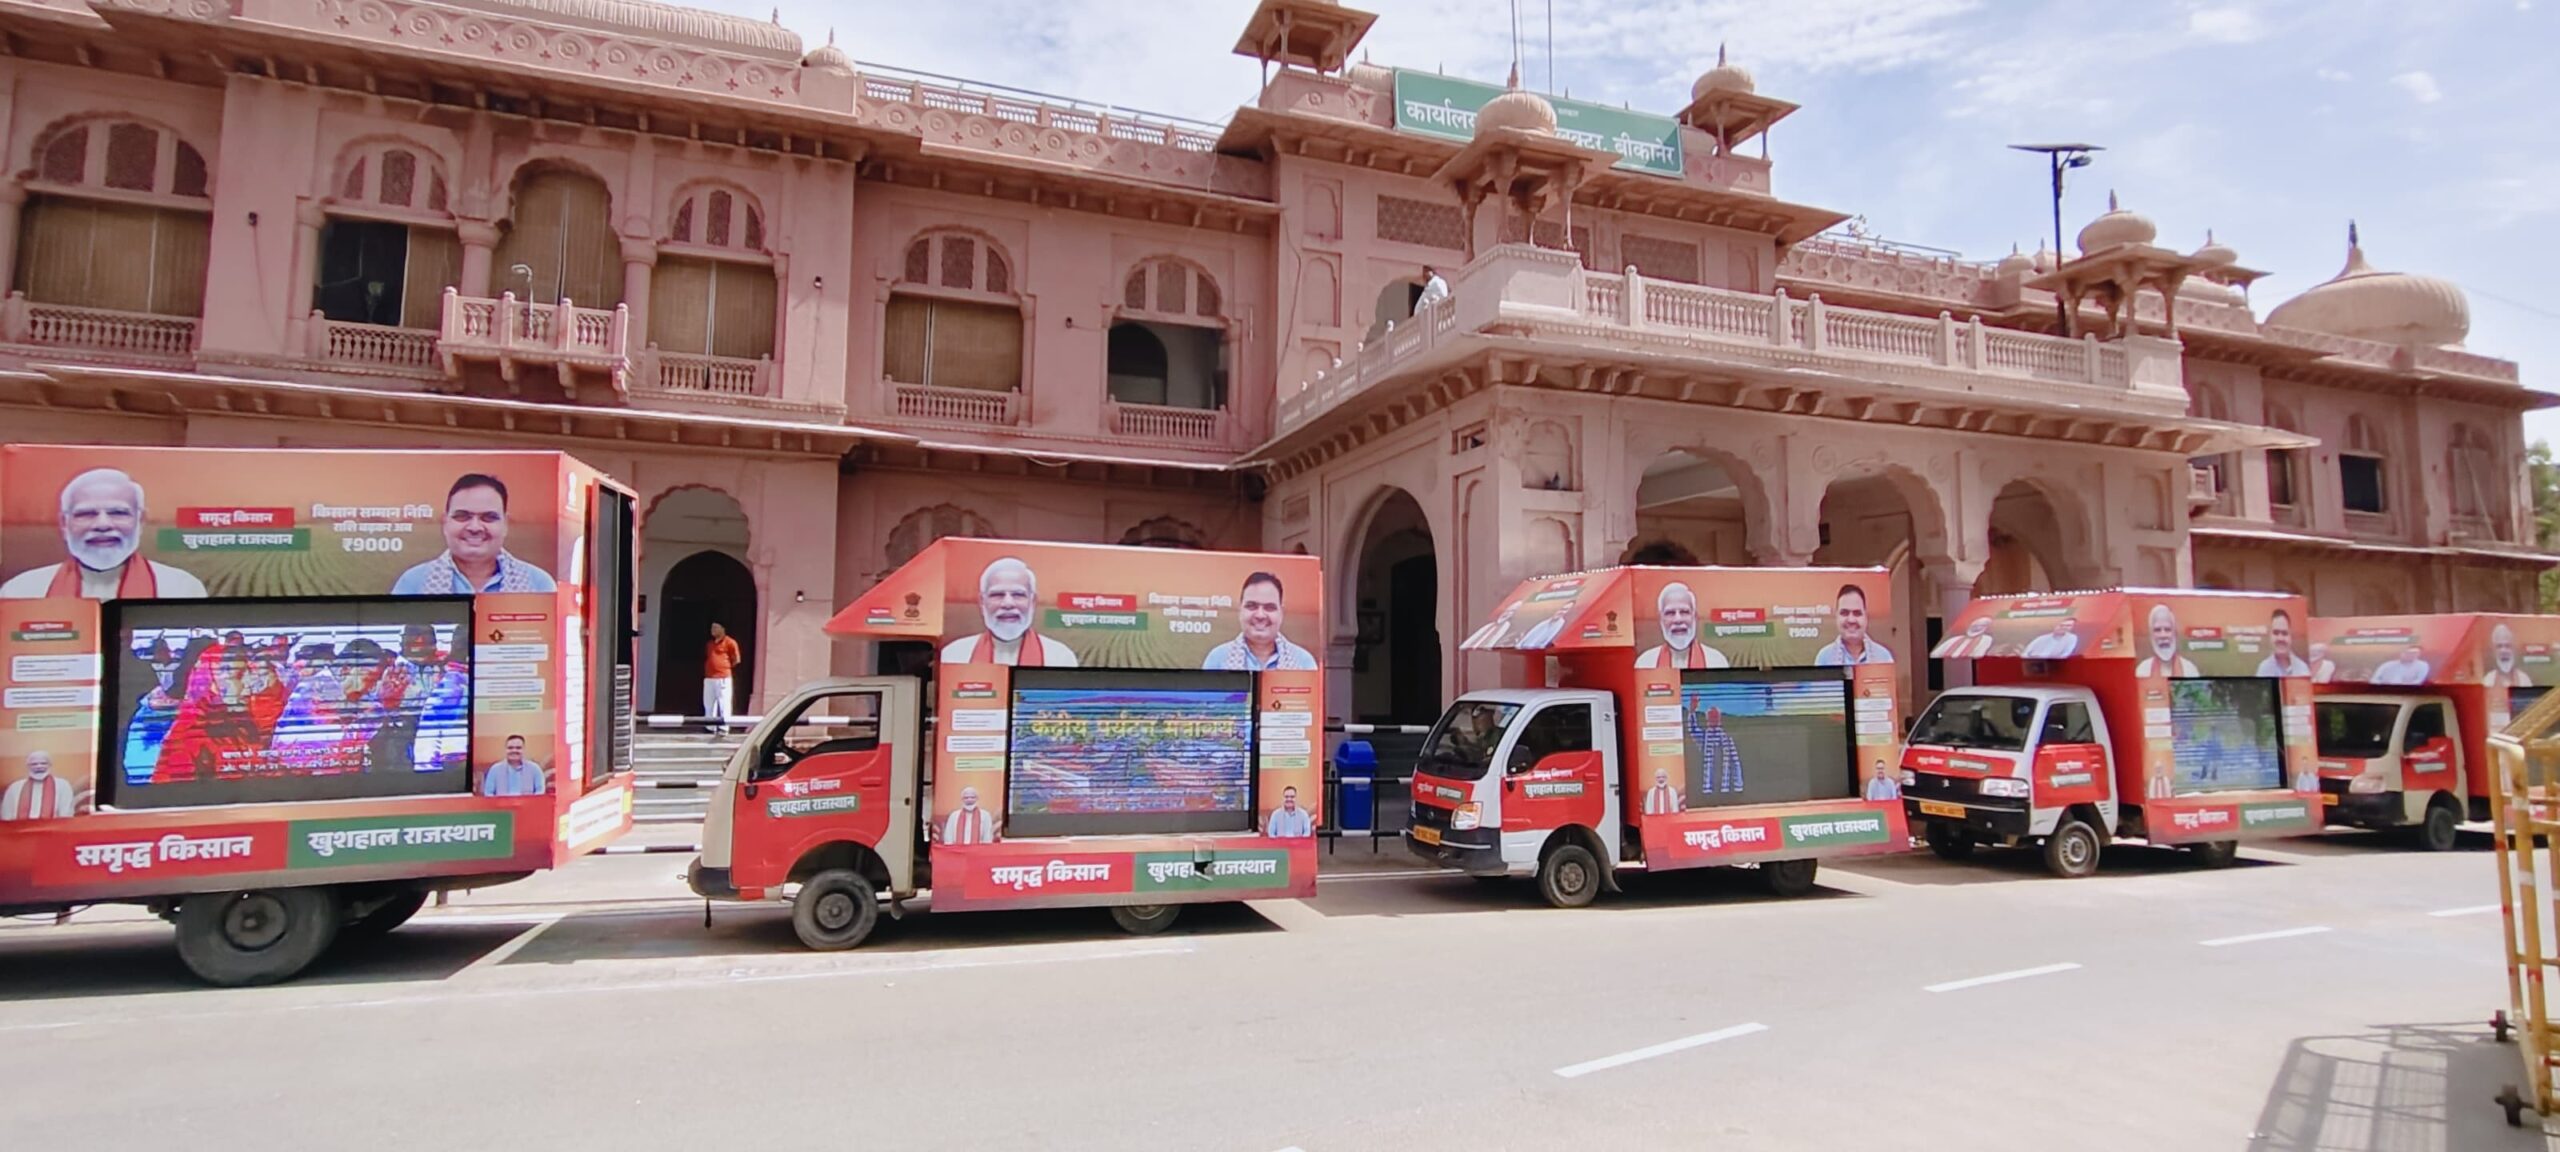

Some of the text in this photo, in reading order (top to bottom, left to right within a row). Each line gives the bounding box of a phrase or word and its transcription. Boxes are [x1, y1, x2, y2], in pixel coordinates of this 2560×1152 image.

[1612, 132, 1675, 165] बीकानेर
[199, 510, 273, 526] समृद्ध किसान
[312, 504, 433, 518] किसान सम्मान निधि
[183, 532, 293, 548] खुशहाल राजस्थान
[342, 537, 403, 552] ₹9000
[1169, 621, 1211, 633] ₹9000
[784, 778, 841, 796] समृद्ध किसान
[769, 796, 855, 817] खुशहाल राजस्थान
[1684, 819, 1880, 850] समृद्ध किसान खुशहाल राजस्थान
[75, 823, 497, 873] समृद्ध किसान खुशहाल राजस्थान
[991, 859, 1277, 890] समृद्ध किसान खुशहा राजस्थान
